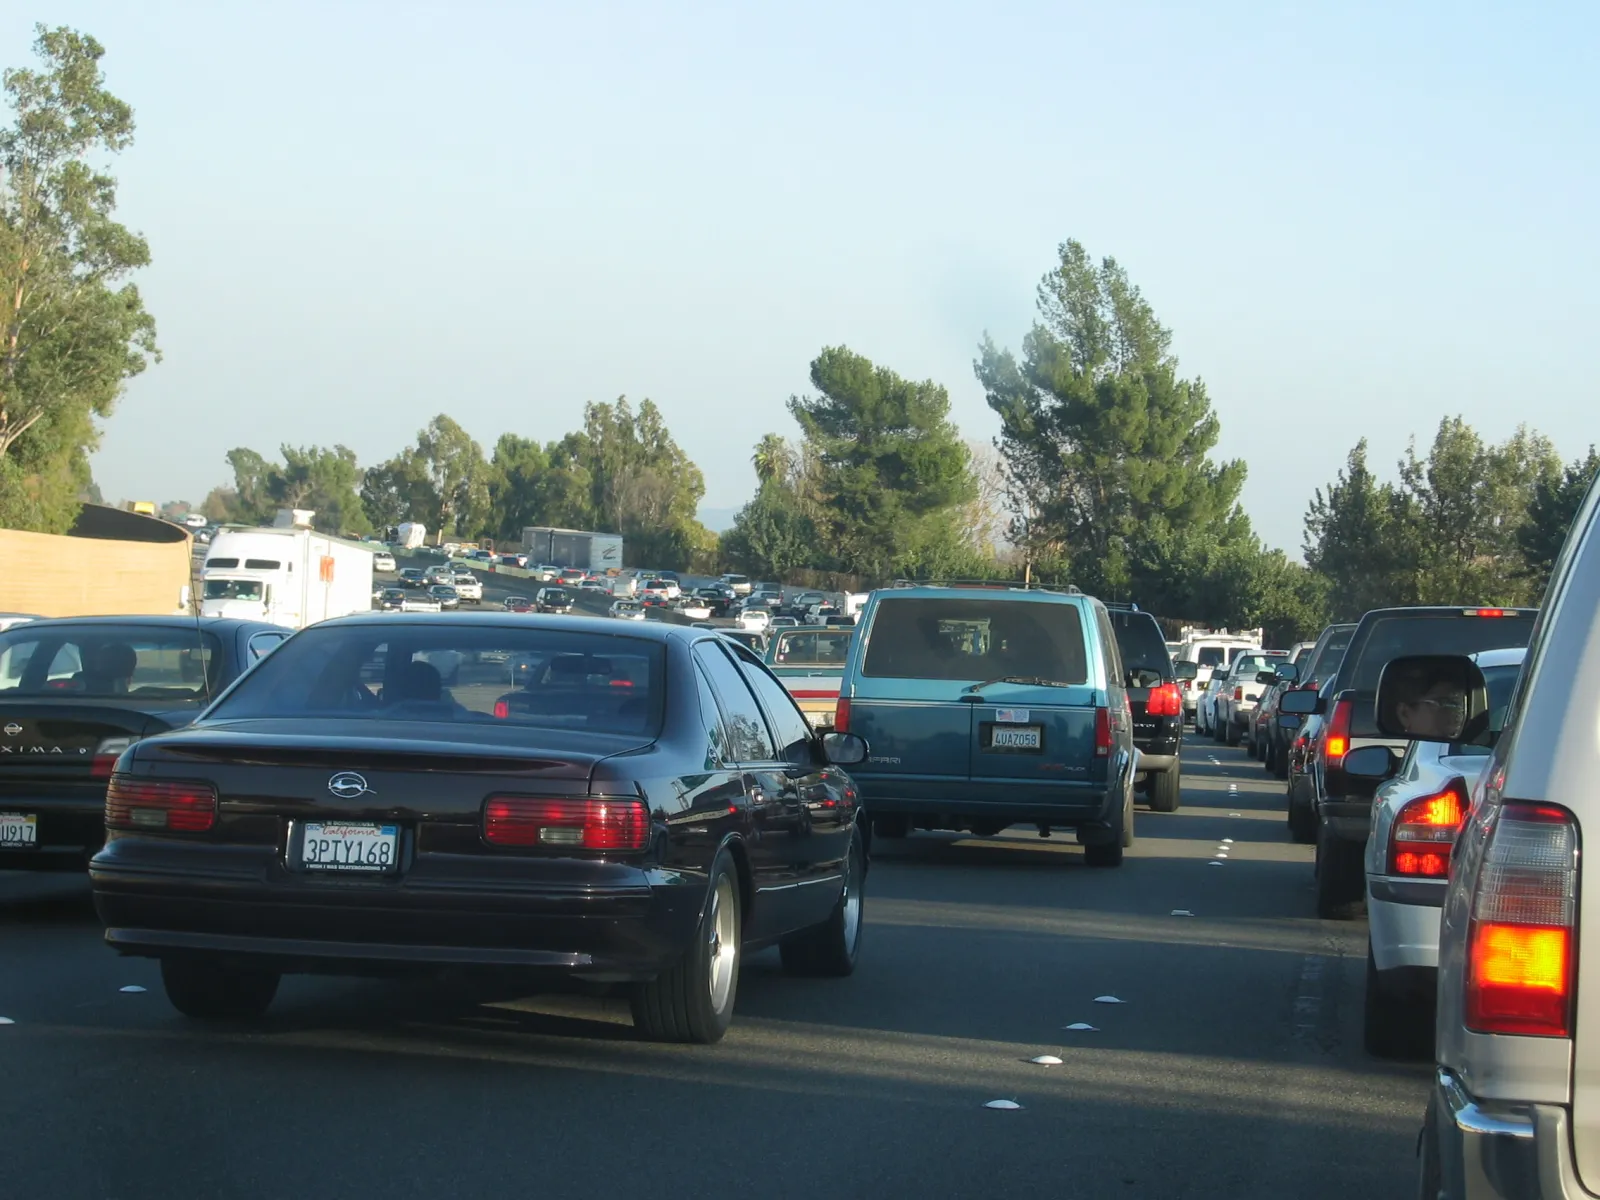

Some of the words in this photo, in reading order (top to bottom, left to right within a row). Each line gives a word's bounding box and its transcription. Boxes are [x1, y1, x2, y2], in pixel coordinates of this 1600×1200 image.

[995, 732, 1037, 746] 4UAZ058
[322, 825, 380, 838] California
[306, 838, 391, 865] 3PTY168
